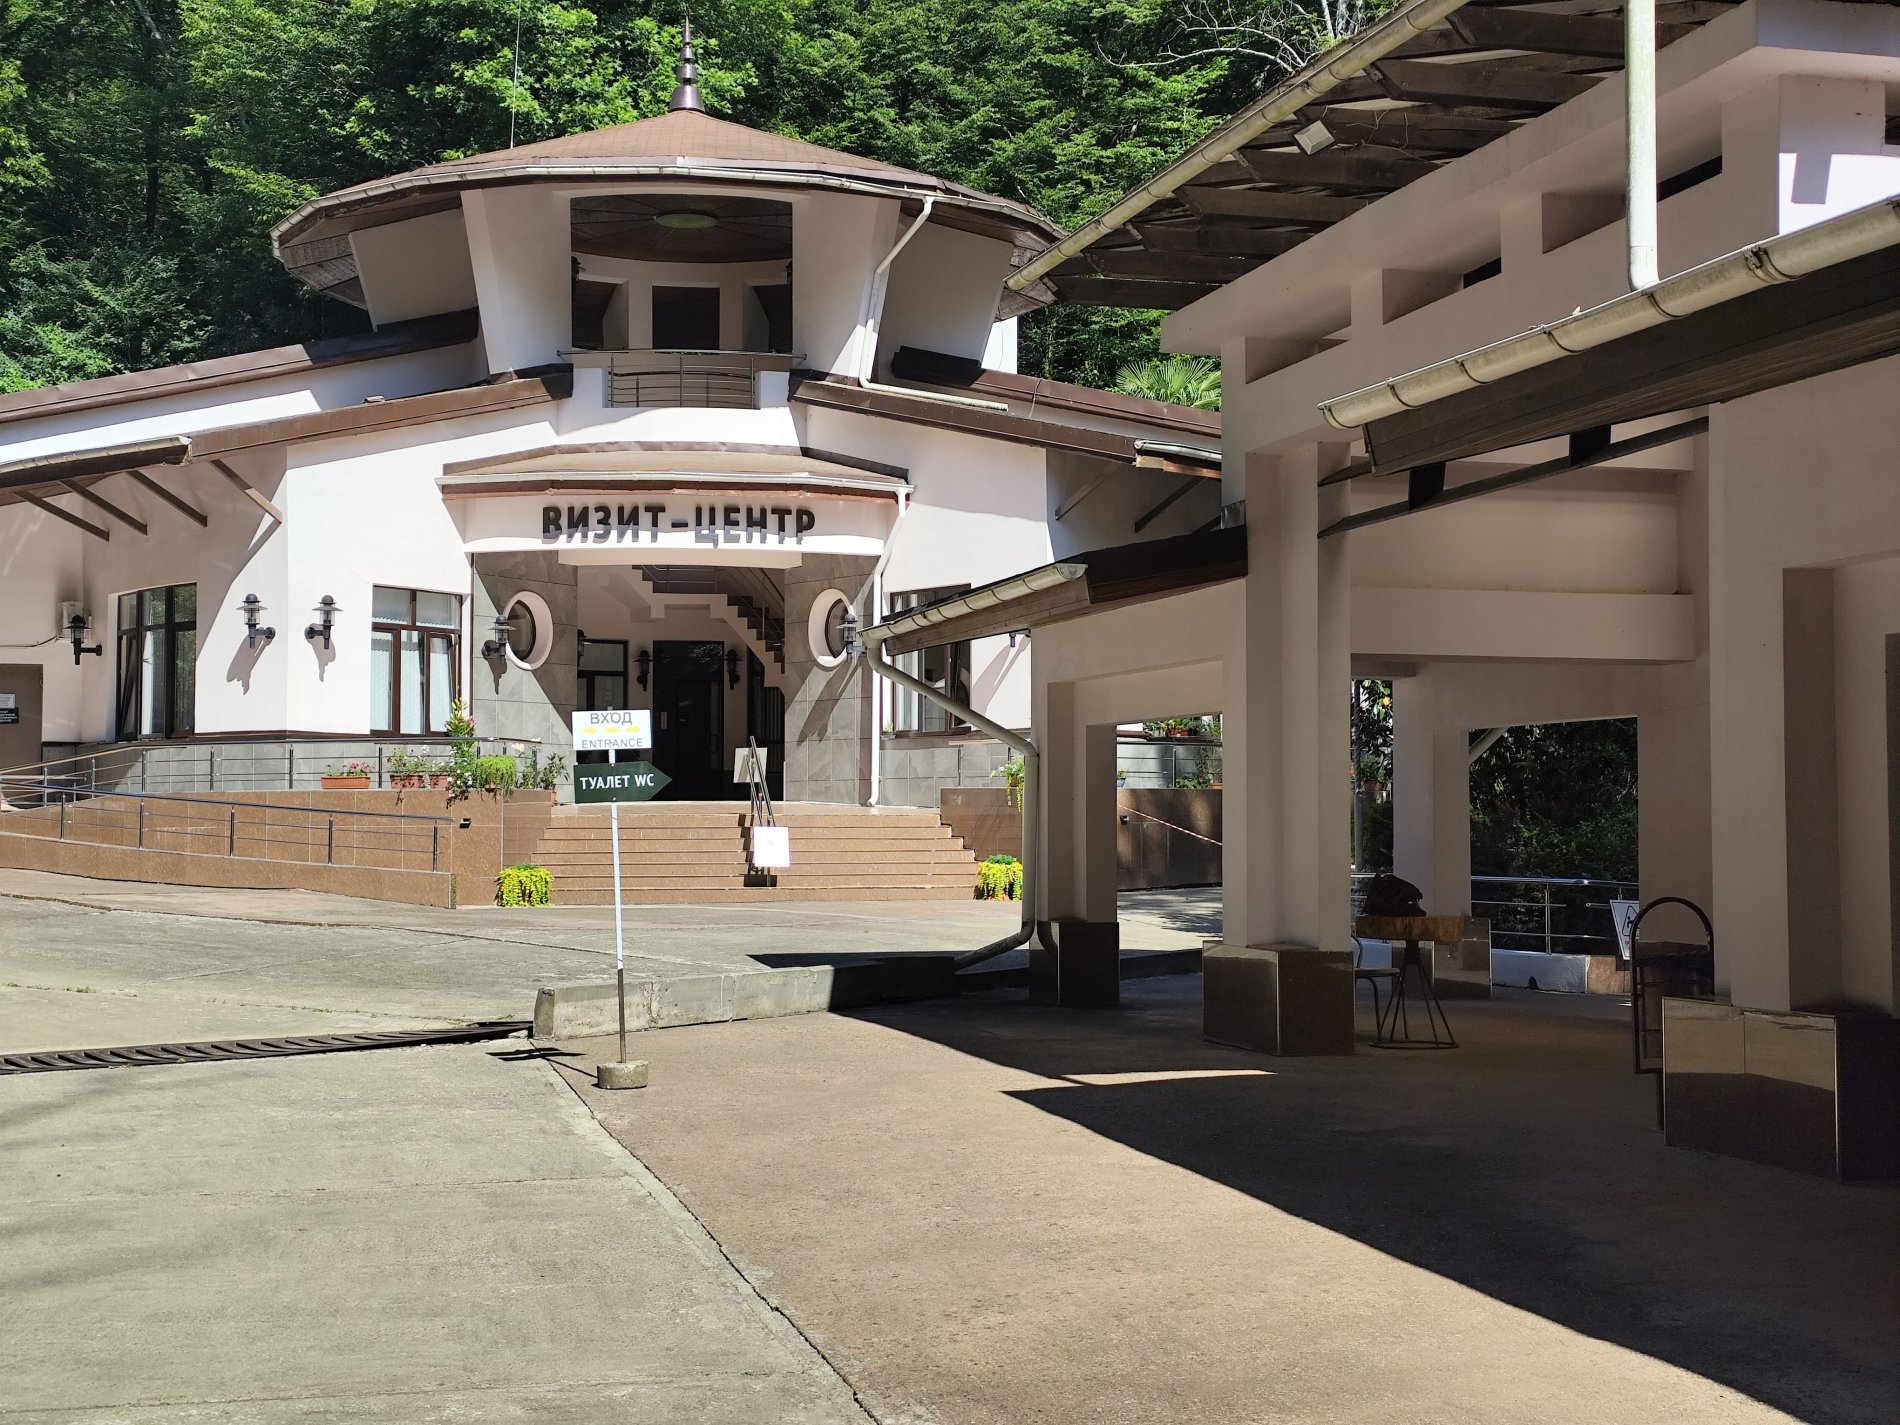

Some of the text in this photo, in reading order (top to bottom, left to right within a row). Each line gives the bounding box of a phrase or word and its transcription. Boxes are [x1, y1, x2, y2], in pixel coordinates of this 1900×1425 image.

[542, 506, 816, 548] ВИЗИТ-ЦЕНТР
[590, 712, 632, 725] ВХОД
[581, 738, 644, 749] ENTRANCE
[580, 774, 655, 790] ТУАЛЕТ WC
